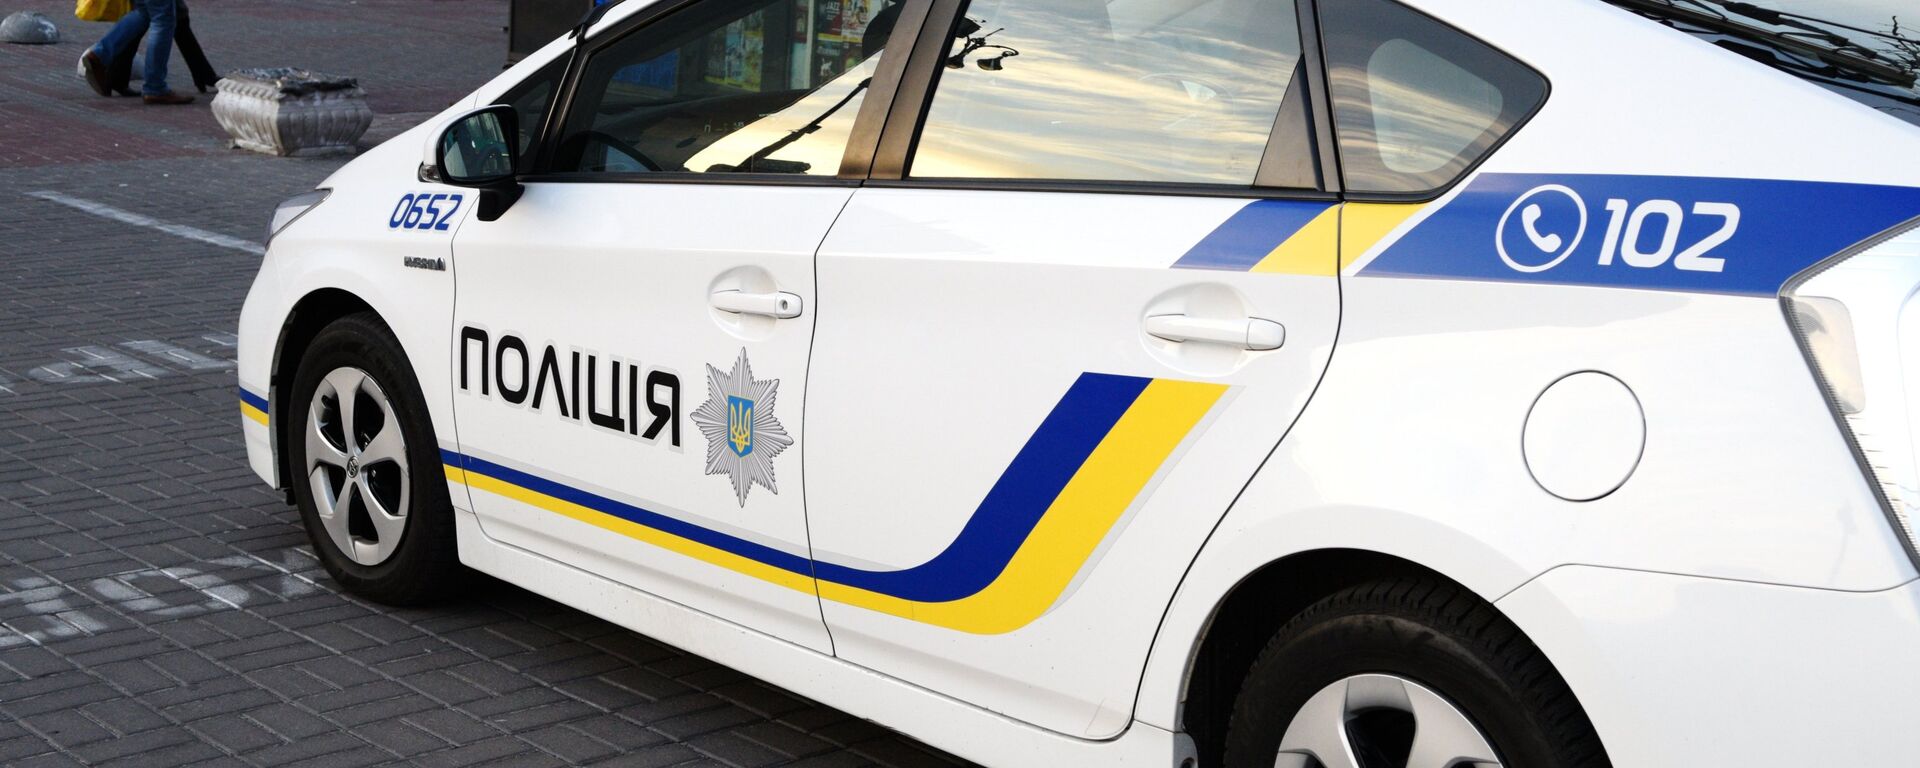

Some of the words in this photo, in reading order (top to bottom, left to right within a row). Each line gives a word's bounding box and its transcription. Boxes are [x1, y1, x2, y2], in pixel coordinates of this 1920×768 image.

[389, 193, 463, 231] 0652
[1598, 198, 1741, 273] 102
[460, 326, 681, 448] ПОЛІЦІЯ
